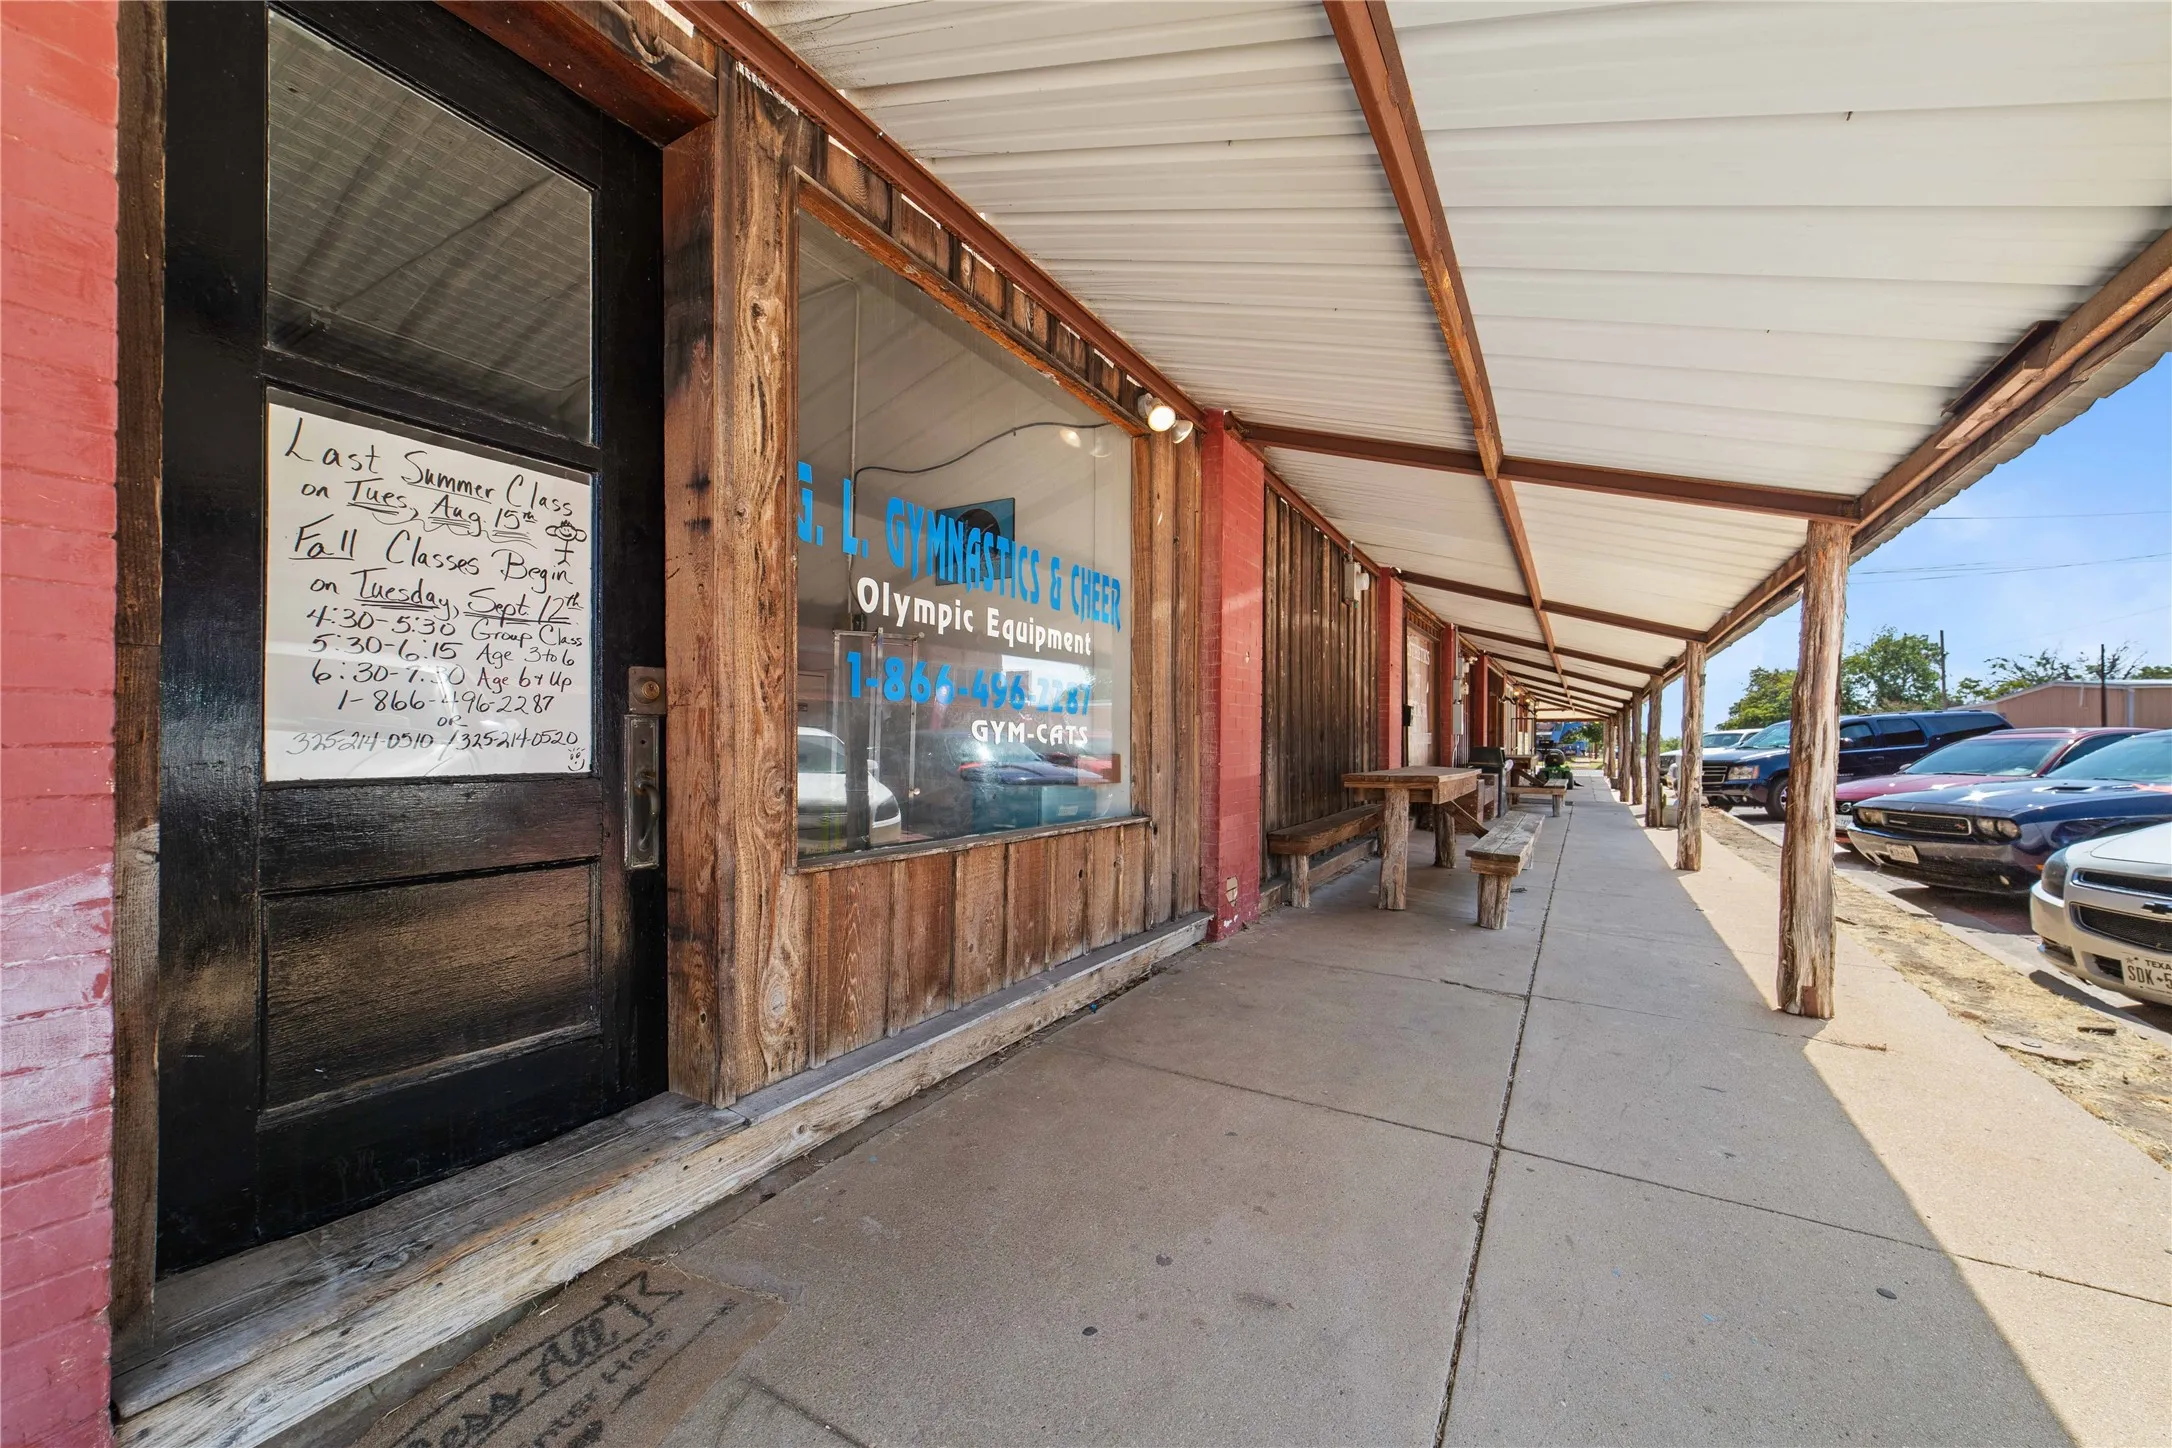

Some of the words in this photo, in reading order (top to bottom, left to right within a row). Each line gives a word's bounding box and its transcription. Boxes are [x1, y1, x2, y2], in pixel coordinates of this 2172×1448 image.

[284, 417, 381, 474] Last
[401, 450, 496, 499] Summer
[506, 474, 573, 516] Class
[301, 483, 330, 499] on
[293, 513, 356, 558] Fall
[385, 529, 480, 576] Classes
[491, 548, 573, 594] Begin
[885, 496, 1041, 605] GYMNASTICS
[1050, 556, 1062, 612] &
[1071, 564, 1122, 633] CHEER
[310, 578, 340, 595] on
[350, 567, 460, 621] Tuesday,
[471, 617, 533, 648] Group
[539, 624, 583, 647] Class
[857, 577, 974, 635] Olympic
[986, 607, 1092, 656] Equipment
[476, 643, 514, 669] Age
[477, 667, 510, 694] Age
[549, 671, 572, 692] Up
[971, 720, 1089, 747] GYM-CATS
